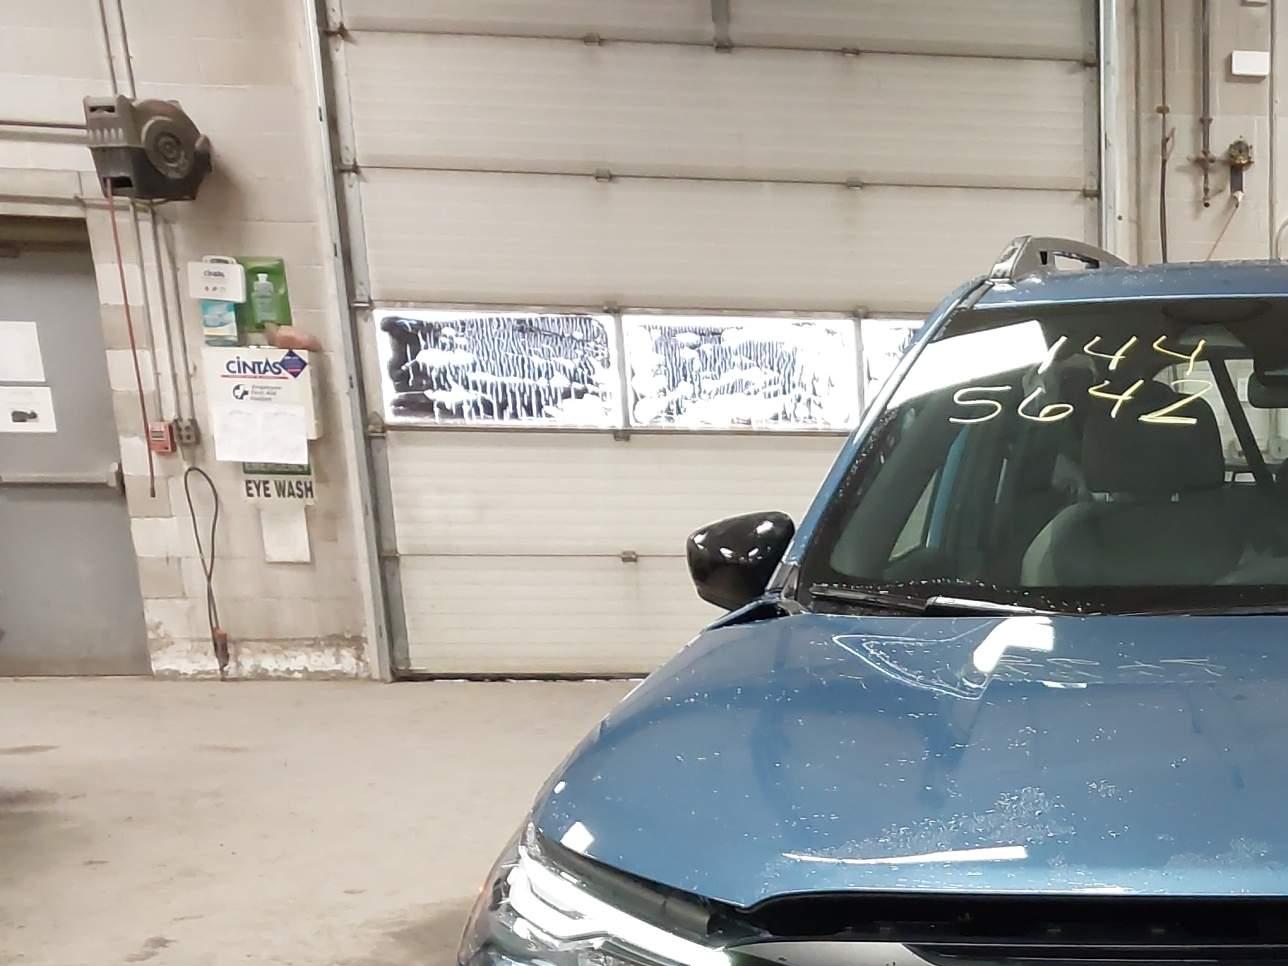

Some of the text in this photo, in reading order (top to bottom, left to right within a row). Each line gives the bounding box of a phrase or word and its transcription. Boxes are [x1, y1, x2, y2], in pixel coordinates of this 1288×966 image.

[949, 379, 1213, 424] 5642
[245, 480, 314, 499] EYE WASH
